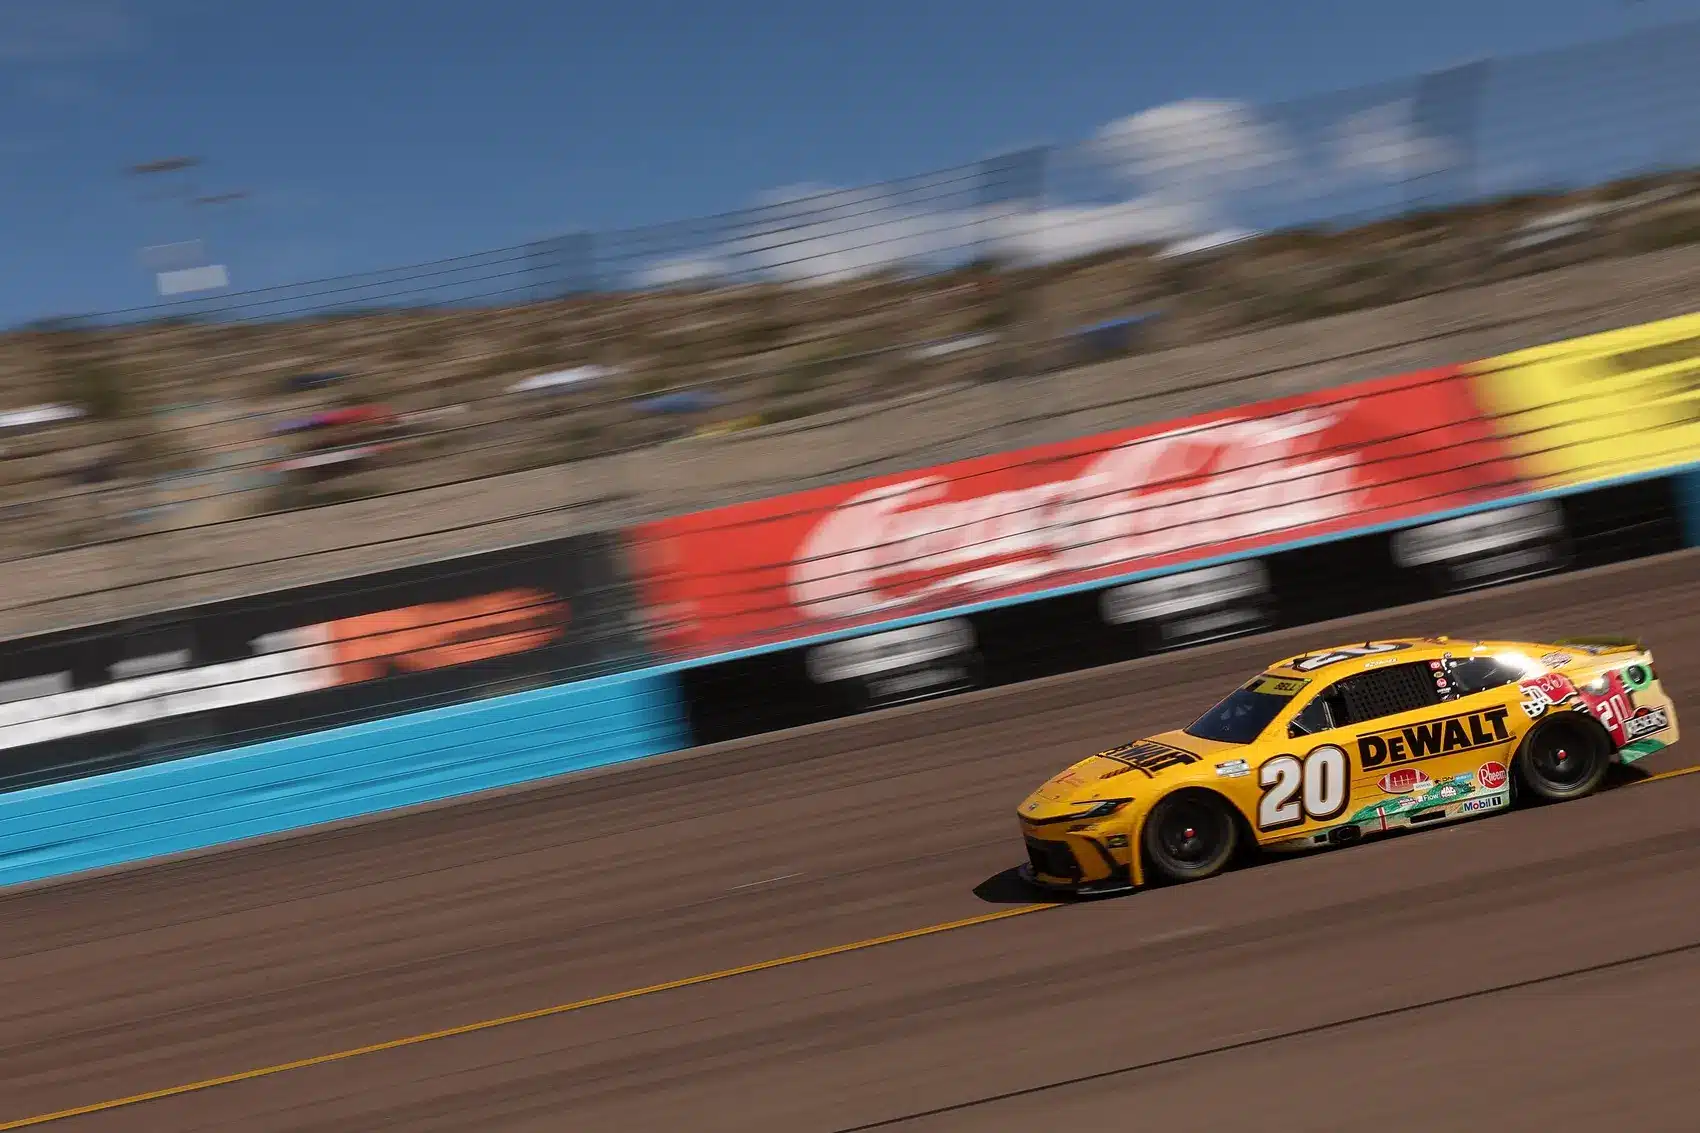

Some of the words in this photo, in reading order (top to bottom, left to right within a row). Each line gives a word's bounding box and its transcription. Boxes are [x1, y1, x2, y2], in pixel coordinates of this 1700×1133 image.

[1275, 681, 1296, 691] BELL
[1357, 709, 1509, 768] DEWALT
[1481, 763, 1506, 785] Rheem
[1258, 743, 1351, 832] 20
[1464, 801, 1491, 812] Mobil
[1492, 796, 1502, 806] 1
